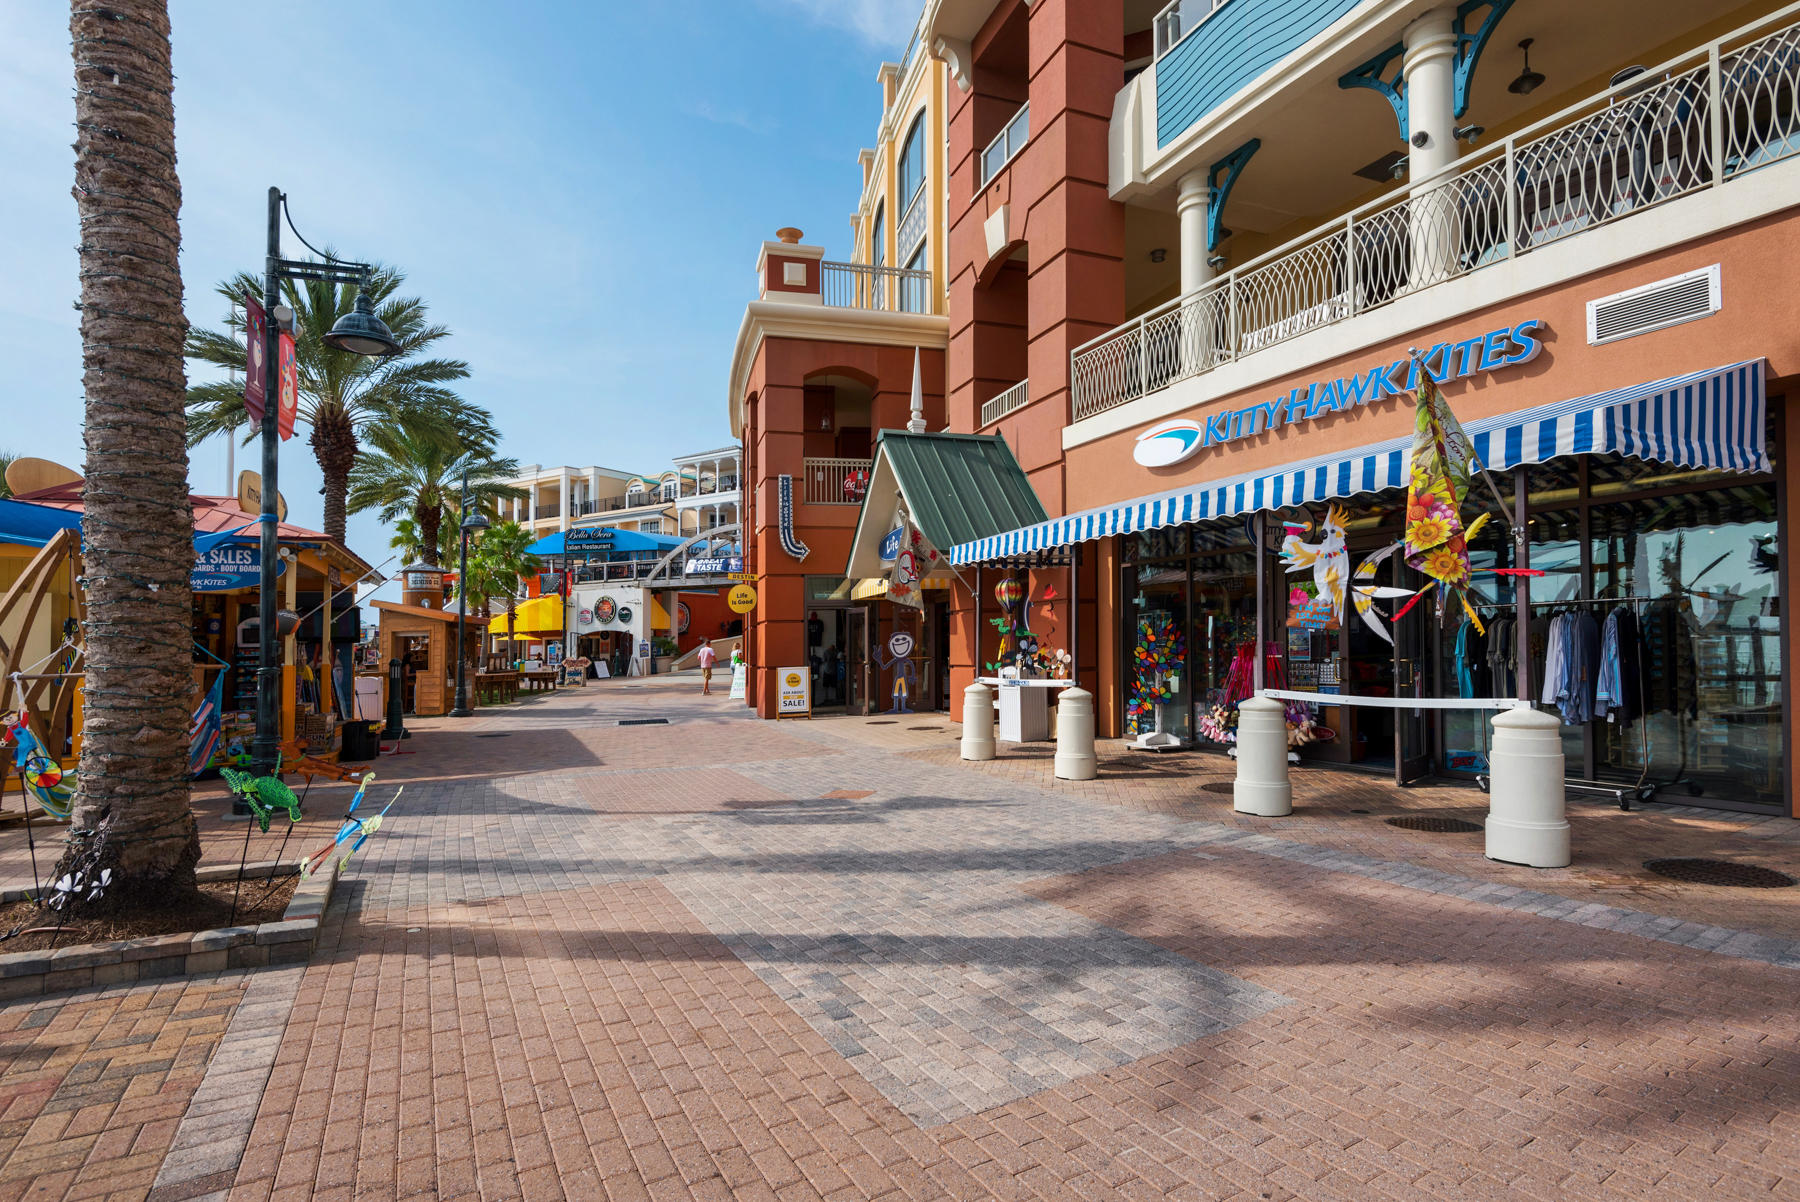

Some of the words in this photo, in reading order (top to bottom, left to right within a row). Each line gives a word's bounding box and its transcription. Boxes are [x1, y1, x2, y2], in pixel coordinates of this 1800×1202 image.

[1203, 396, 1286, 448] KITTY
[1285, 360, 1404, 422] HAWK
[1404, 319, 1541, 391] KITES
[886, 535, 899, 554] Life
[210, 549, 252, 564] SALES
[696, 564, 722, 572] TASTE
[203, 578, 227, 586] KITES
[1296, 612, 1331, 621] ISLAND
[1300, 620, 1326, 630] TIME!
[783, 699, 805, 707] SALE!
